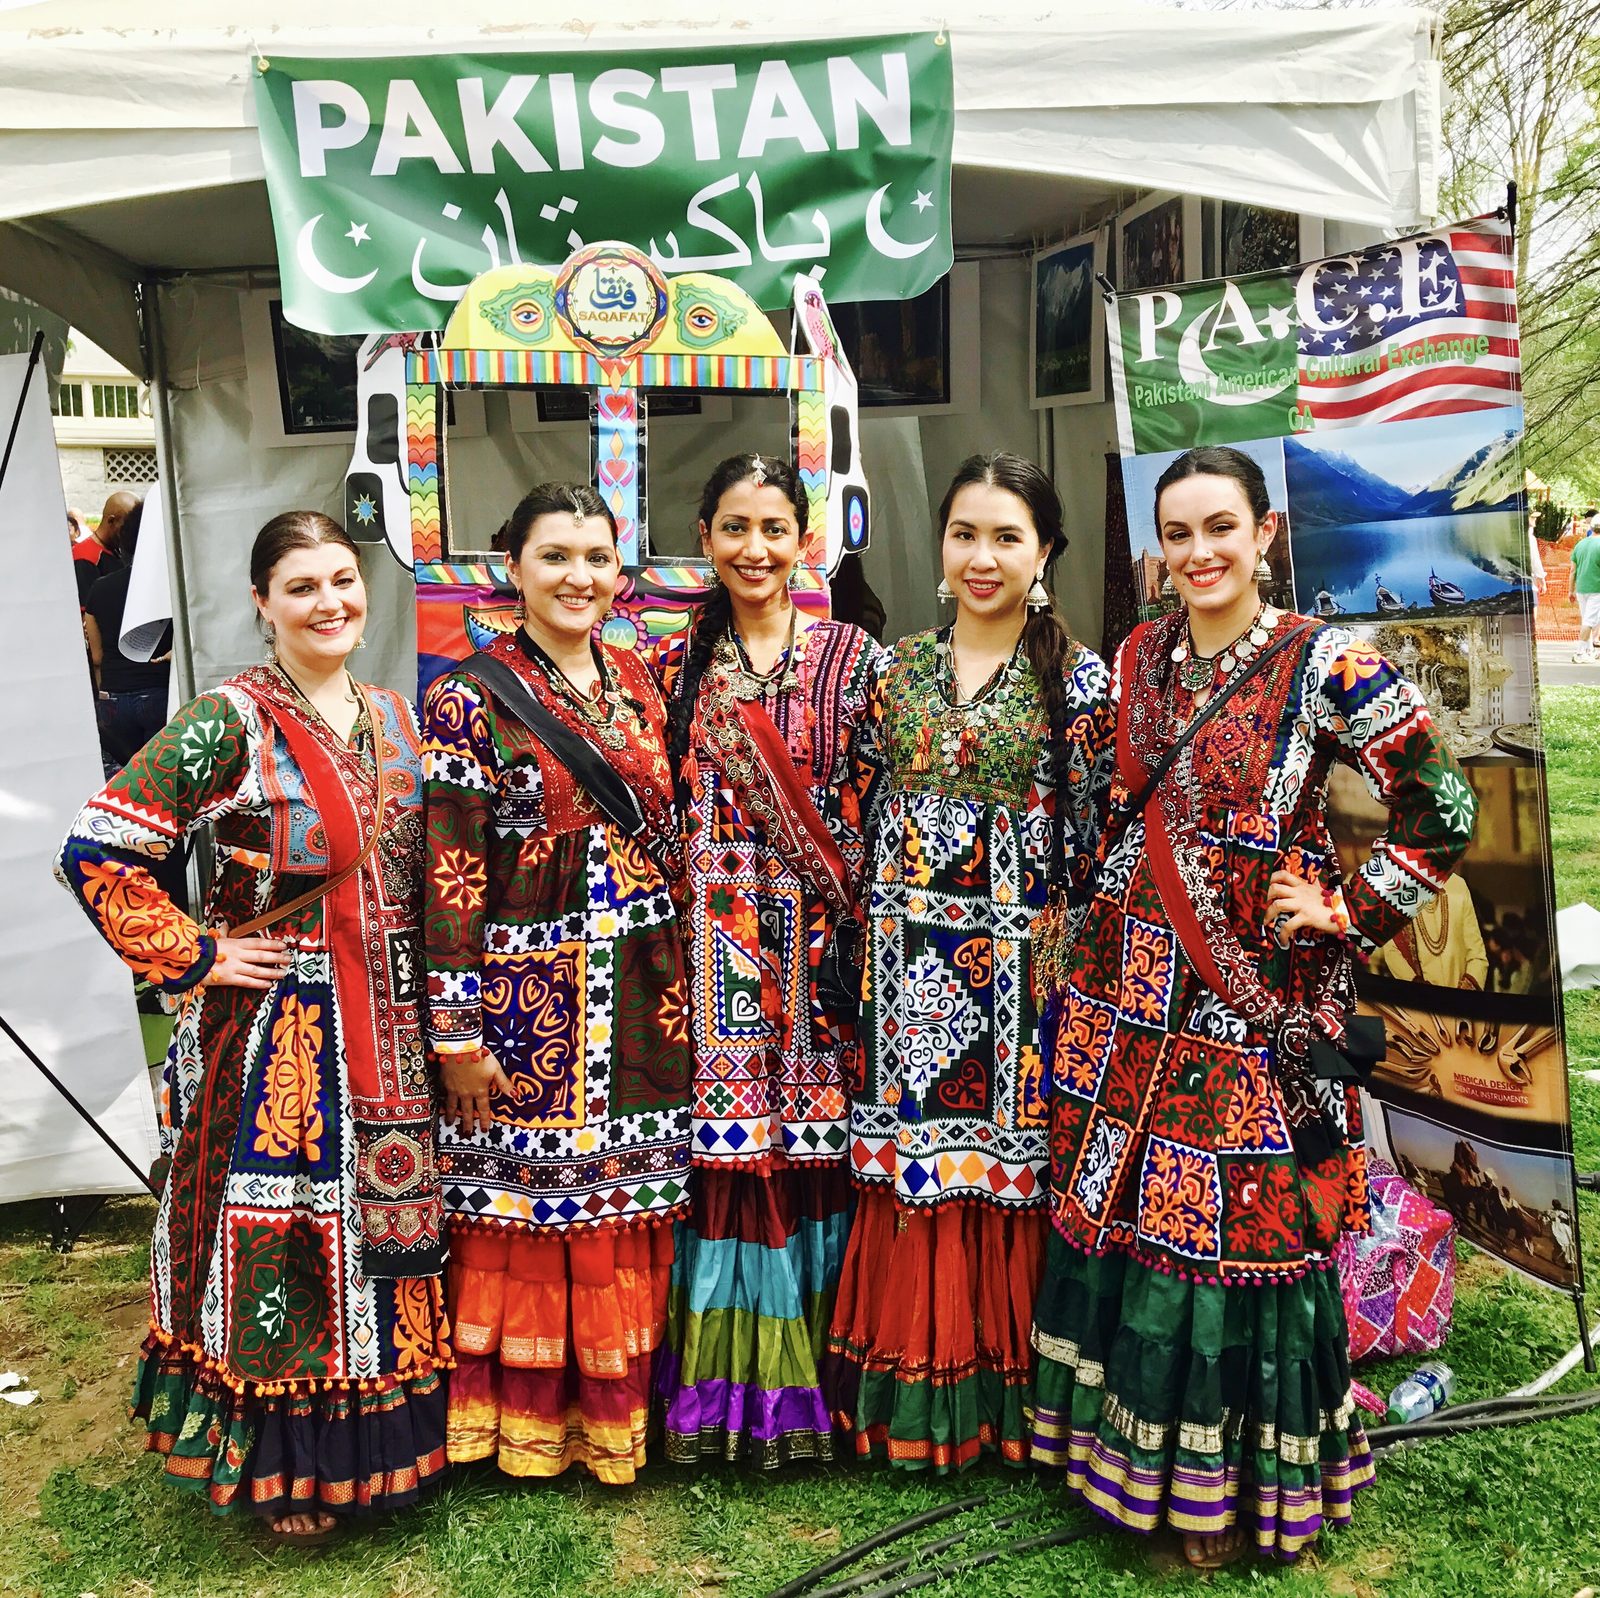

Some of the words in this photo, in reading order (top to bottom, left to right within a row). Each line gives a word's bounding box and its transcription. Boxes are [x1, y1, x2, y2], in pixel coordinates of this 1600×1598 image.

[291, 53, 912, 177] PAKISTAN
[578, 311, 648, 323] SAQAFAT
[1134, 378, 1211, 408] Pakistani
[1215, 364, 1299, 396] American
[1306, 345, 1381, 382] Cultural
[1387, 334, 1490, 369] Exchange
[1288, 405, 1316, 432] GA
[604, 628, 630, 643] OK
[1454, 1072, 1488, 1087] MEDICAL
[1455, 1085, 1479, 1097] DENTAL
[1480, 1092, 1529, 1104] INSTRUMENTS
